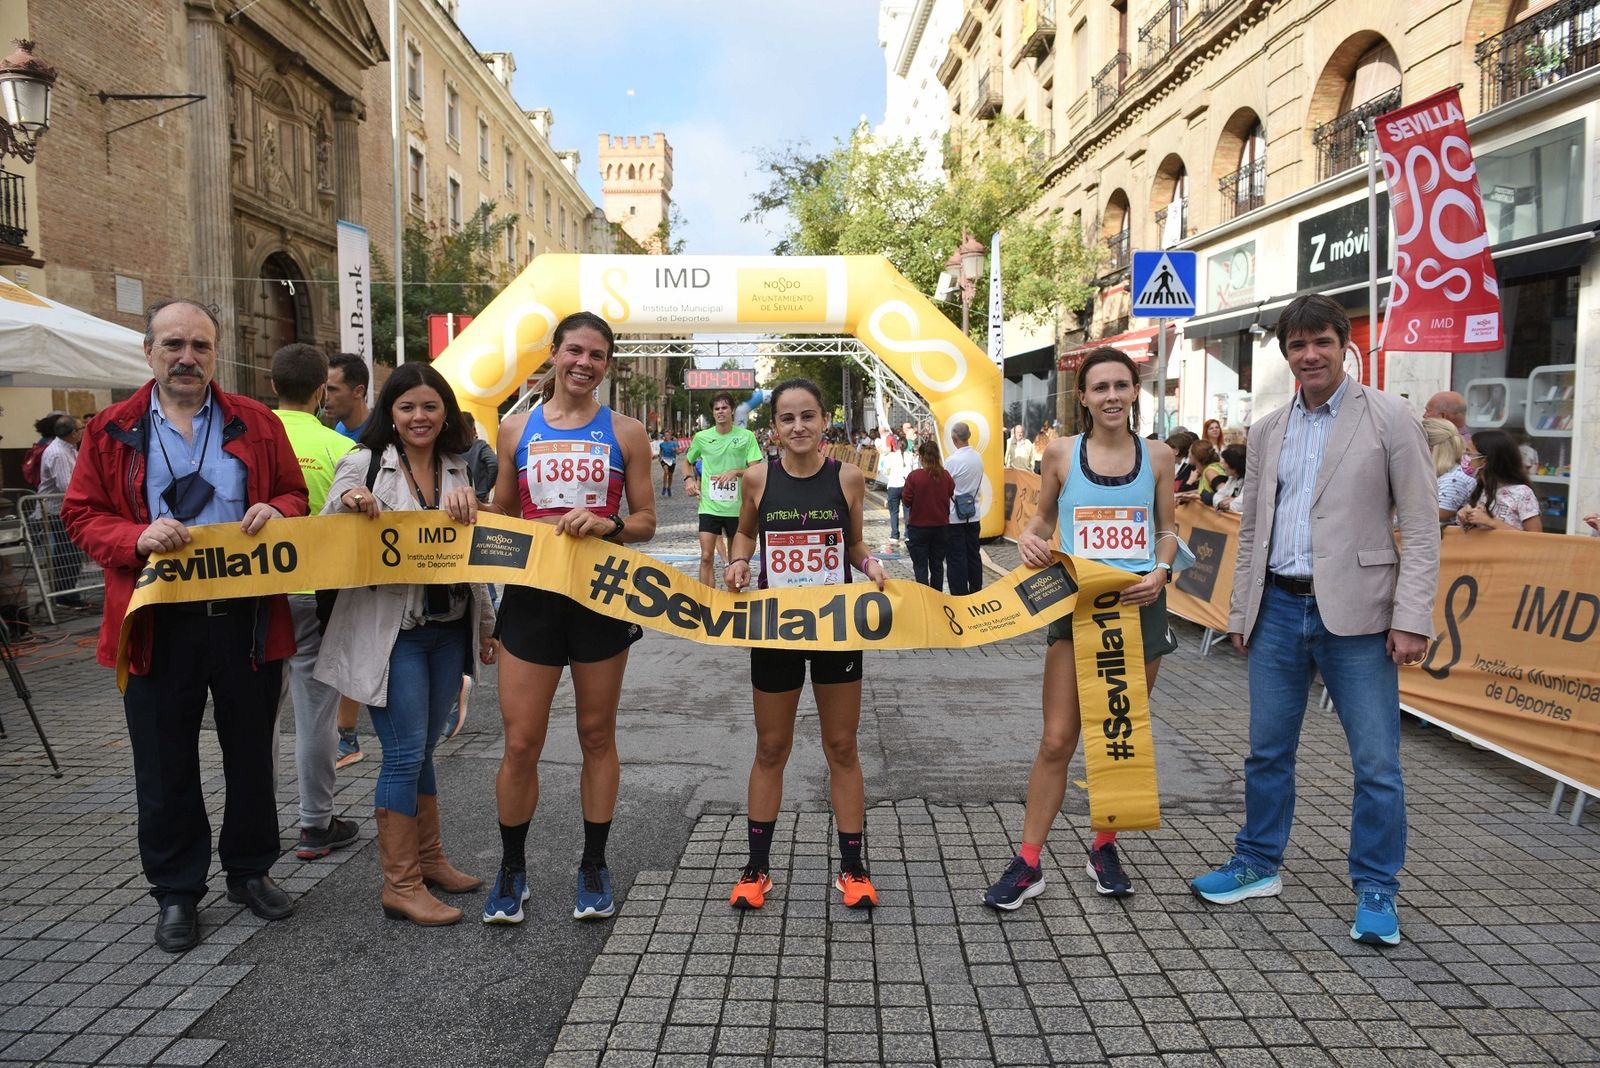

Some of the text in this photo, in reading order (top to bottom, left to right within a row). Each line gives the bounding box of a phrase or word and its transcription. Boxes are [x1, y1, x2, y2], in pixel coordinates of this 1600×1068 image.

[1386, 101, 1464, 142] SEVILLA
[1310, 227, 1370, 273] Z móvi
[655, 268, 711, 289] IMD
[349, 264, 365, 360] xaBank
[642, 304, 723, 315] Instituto Municipal
[656, 314, 710, 323] de Deportes
[1431, 317, 1454, 329] IMD
[532, 458, 605, 482] 13858
[711, 482, 737, 492] 1448
[766, 508, 800, 522] ENTRENA
[808, 509, 839, 520] MEJORA
[418, 527, 457, 544] IMD
[1079, 526, 1146, 550] 13884
[436, 553, 464, 562] Municipal
[476, 543, 521, 553] AYUNTAMIENTO
[428, 561, 457, 569] Deportes
[771, 546, 839, 574] 8856
[589, 555, 893, 642] #Sevilla10
[967, 599, 1002, 617] IMD
[967, 611, 1021, 631] Instituto Municipal
[1511, 584, 1600, 643] IMD
[989, 620, 1016, 631] Deportes
[1092, 590, 1135, 761] #Sevilla10
[1472, 653, 1600, 704] Instituto Municipa
[1485, 680, 1572, 722] de Deportes
